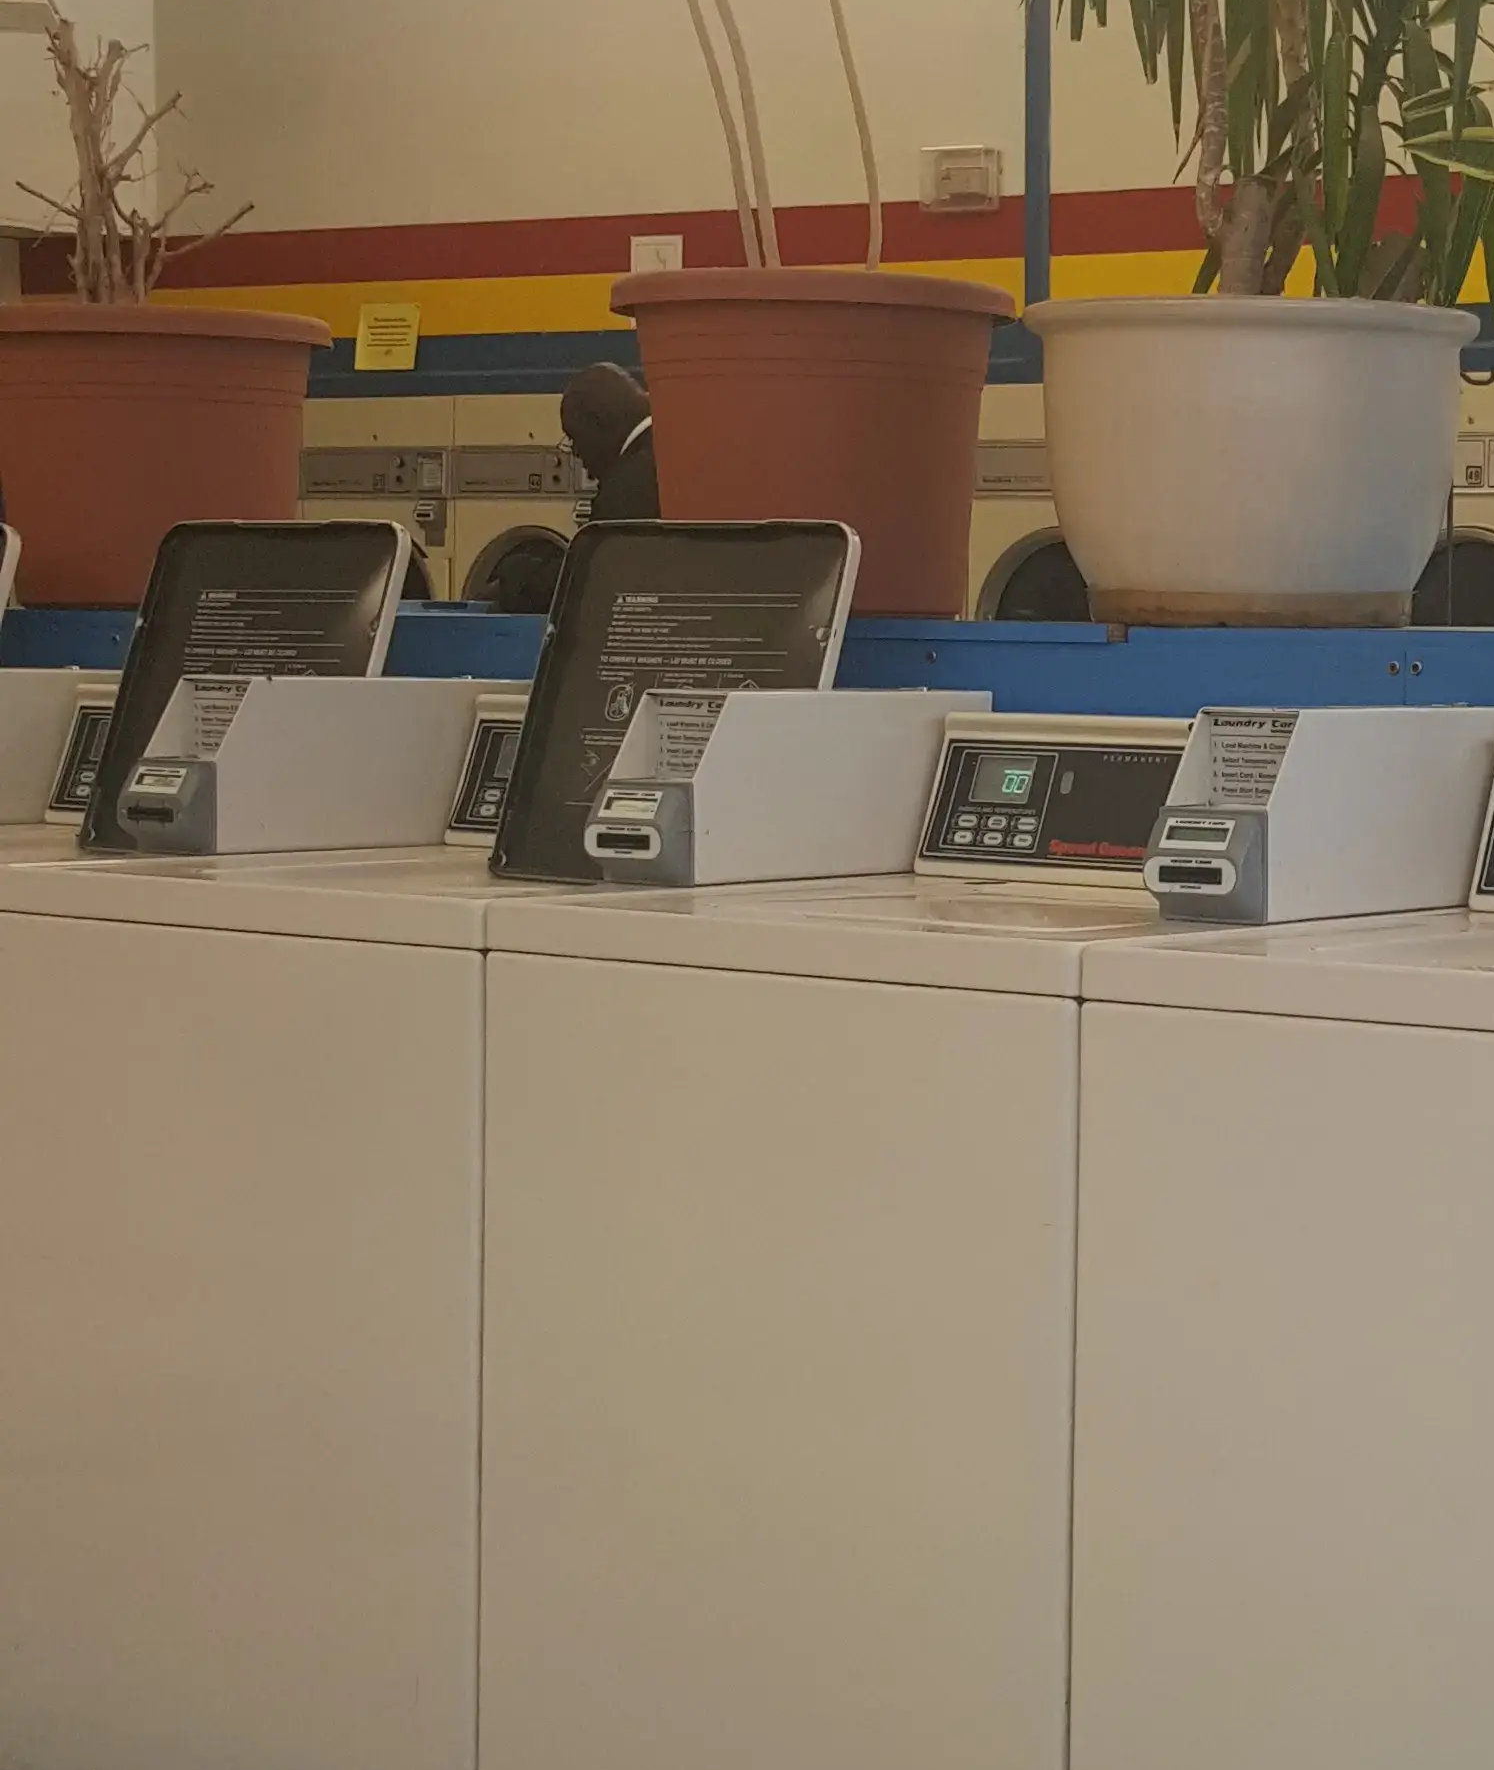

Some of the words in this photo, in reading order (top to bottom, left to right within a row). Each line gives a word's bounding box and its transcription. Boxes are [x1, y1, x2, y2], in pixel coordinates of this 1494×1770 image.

[659, 699, 704, 710] Laundry
[1213, 719, 1267, 729] Laundry
[1271, 720, 1295, 729] Car
[1049, 839, 1098, 856] Speed
